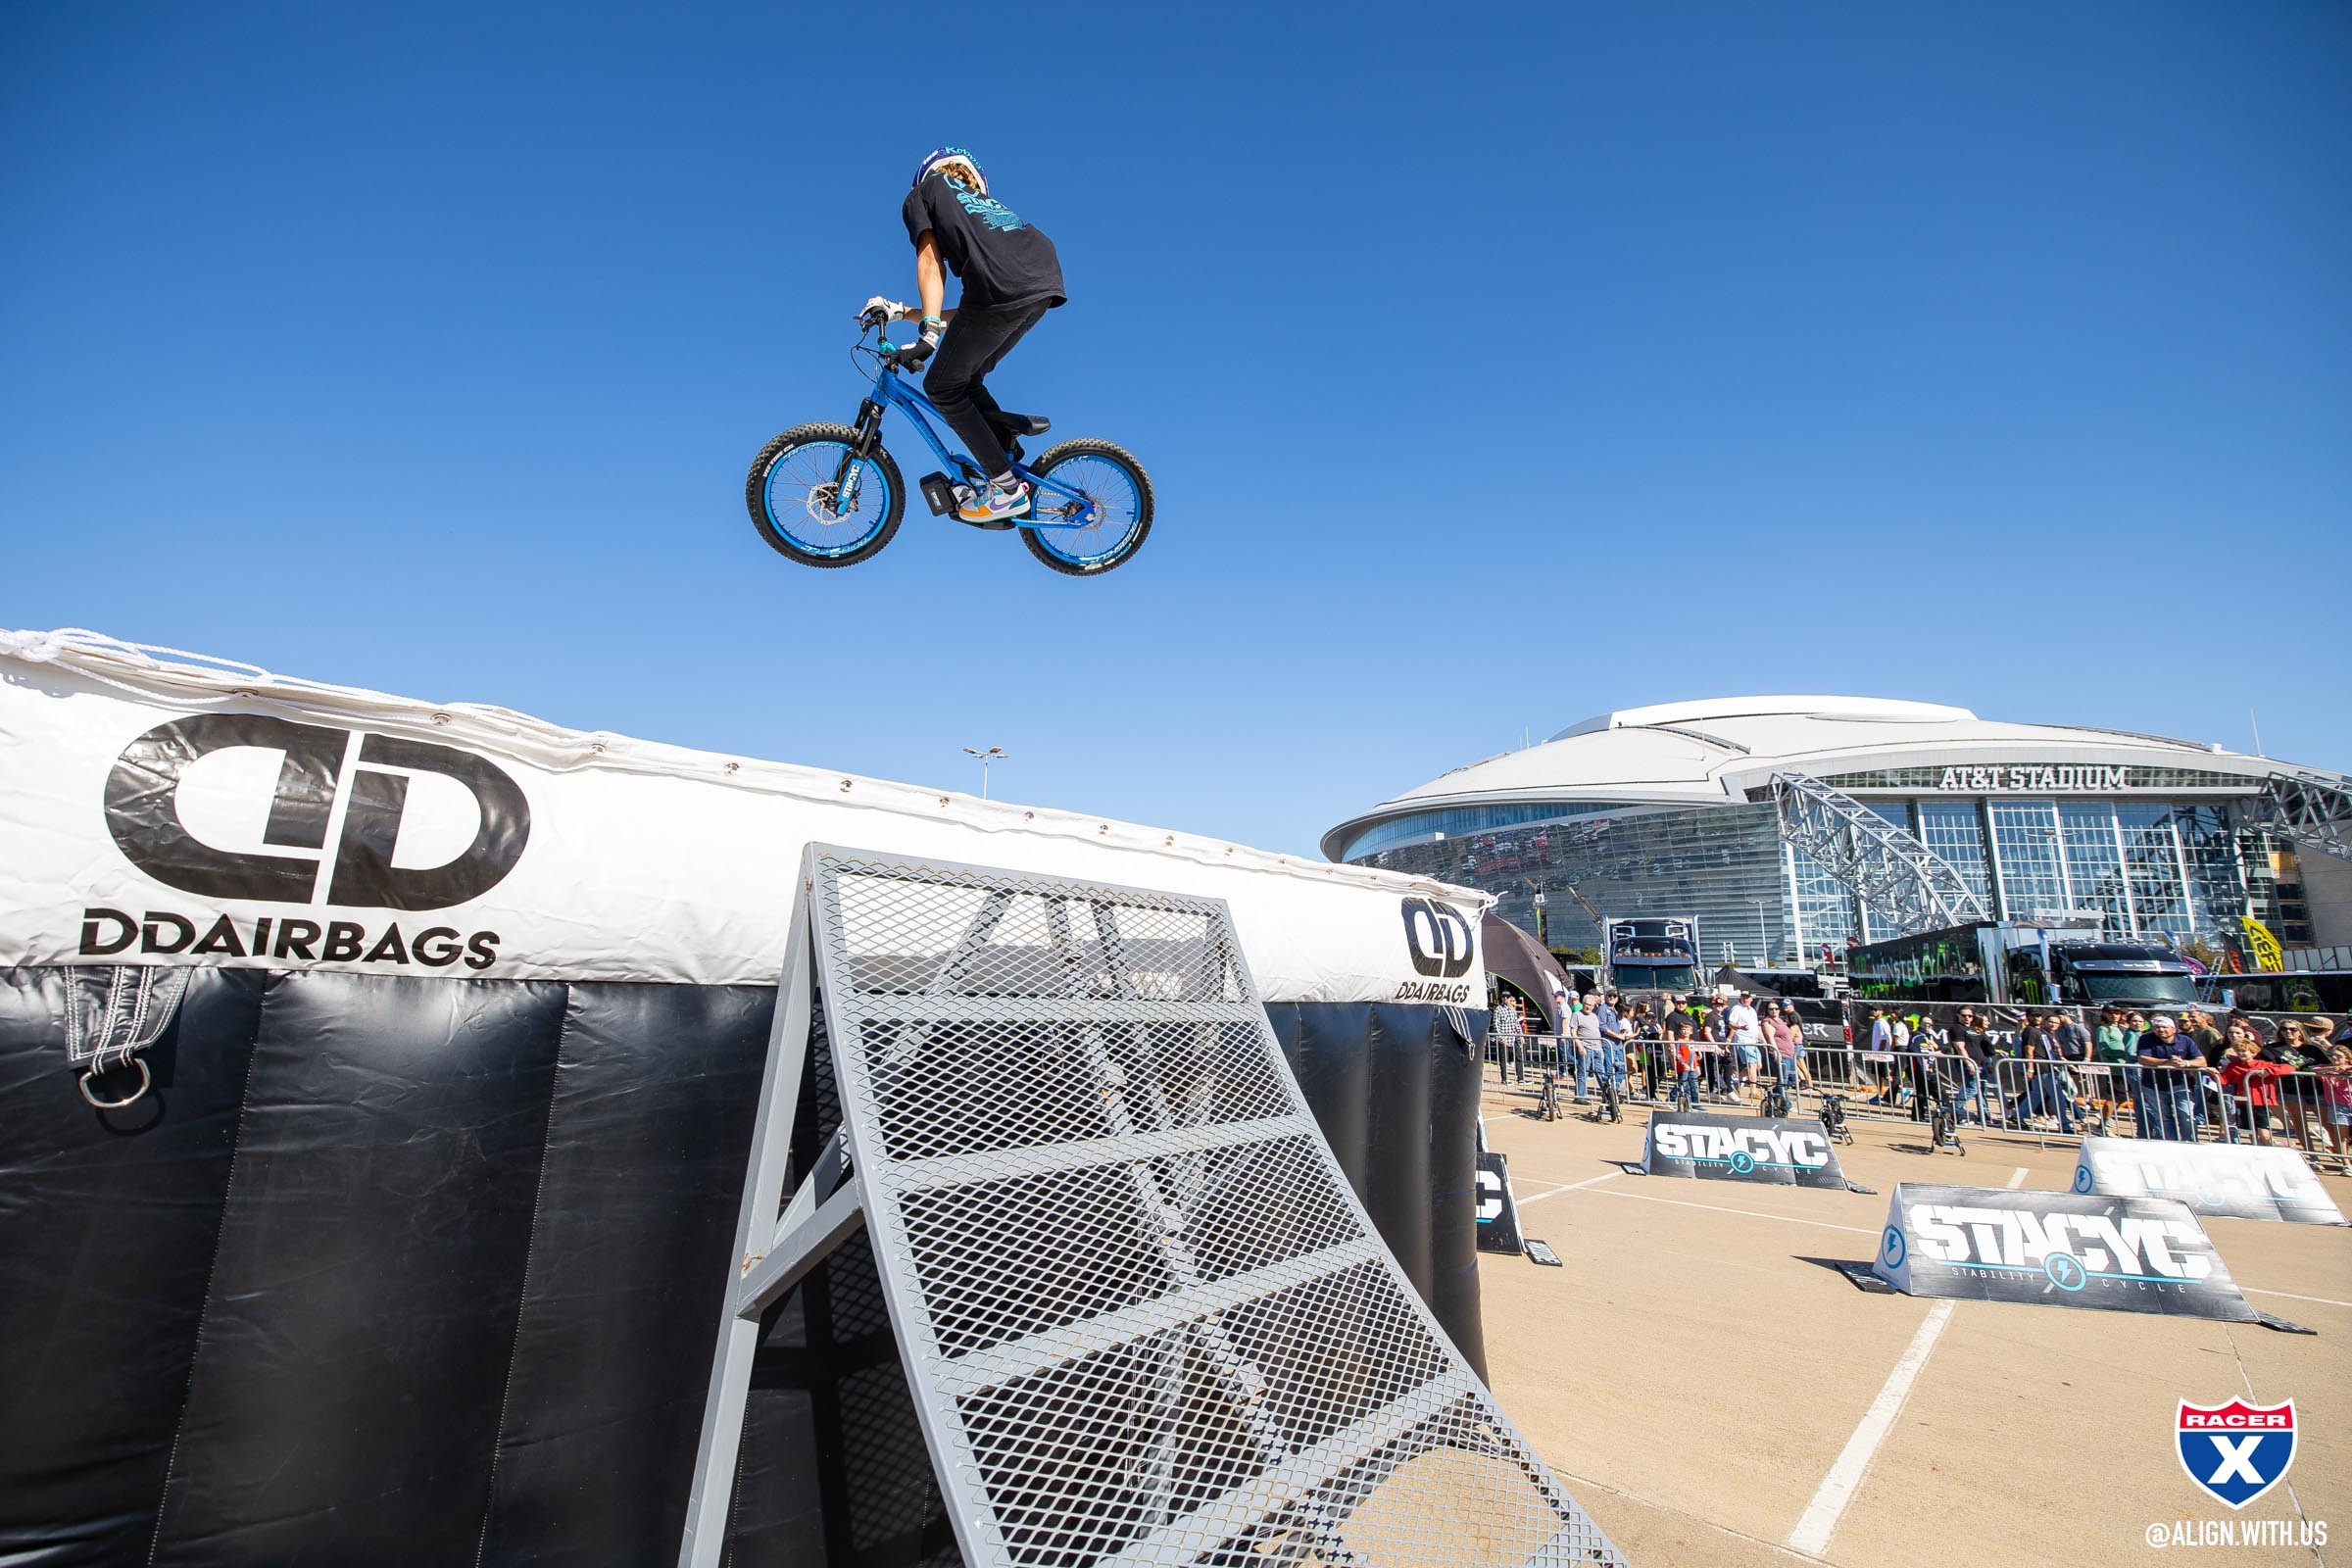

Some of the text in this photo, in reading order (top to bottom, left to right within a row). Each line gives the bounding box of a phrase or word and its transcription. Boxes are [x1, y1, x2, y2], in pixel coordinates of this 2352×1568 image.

[842, 464, 860, 499] STACYC
[1938, 766, 2132, 789] AT&T STADIUM
[78, 907, 501, 970] DDAIRBAGS
[1873, 952, 1924, 987] MONSTER
[1395, 981, 1470, 1003] DDAIRBAGS
[1654, 1123, 1828, 1166] STACYC
[1675, 1158, 1812, 1175] STABILITY CYCLE
[1909, 1202, 2213, 1282] STACYC
[1952, 1267, 2186, 1294] STABILITY CYCLE
